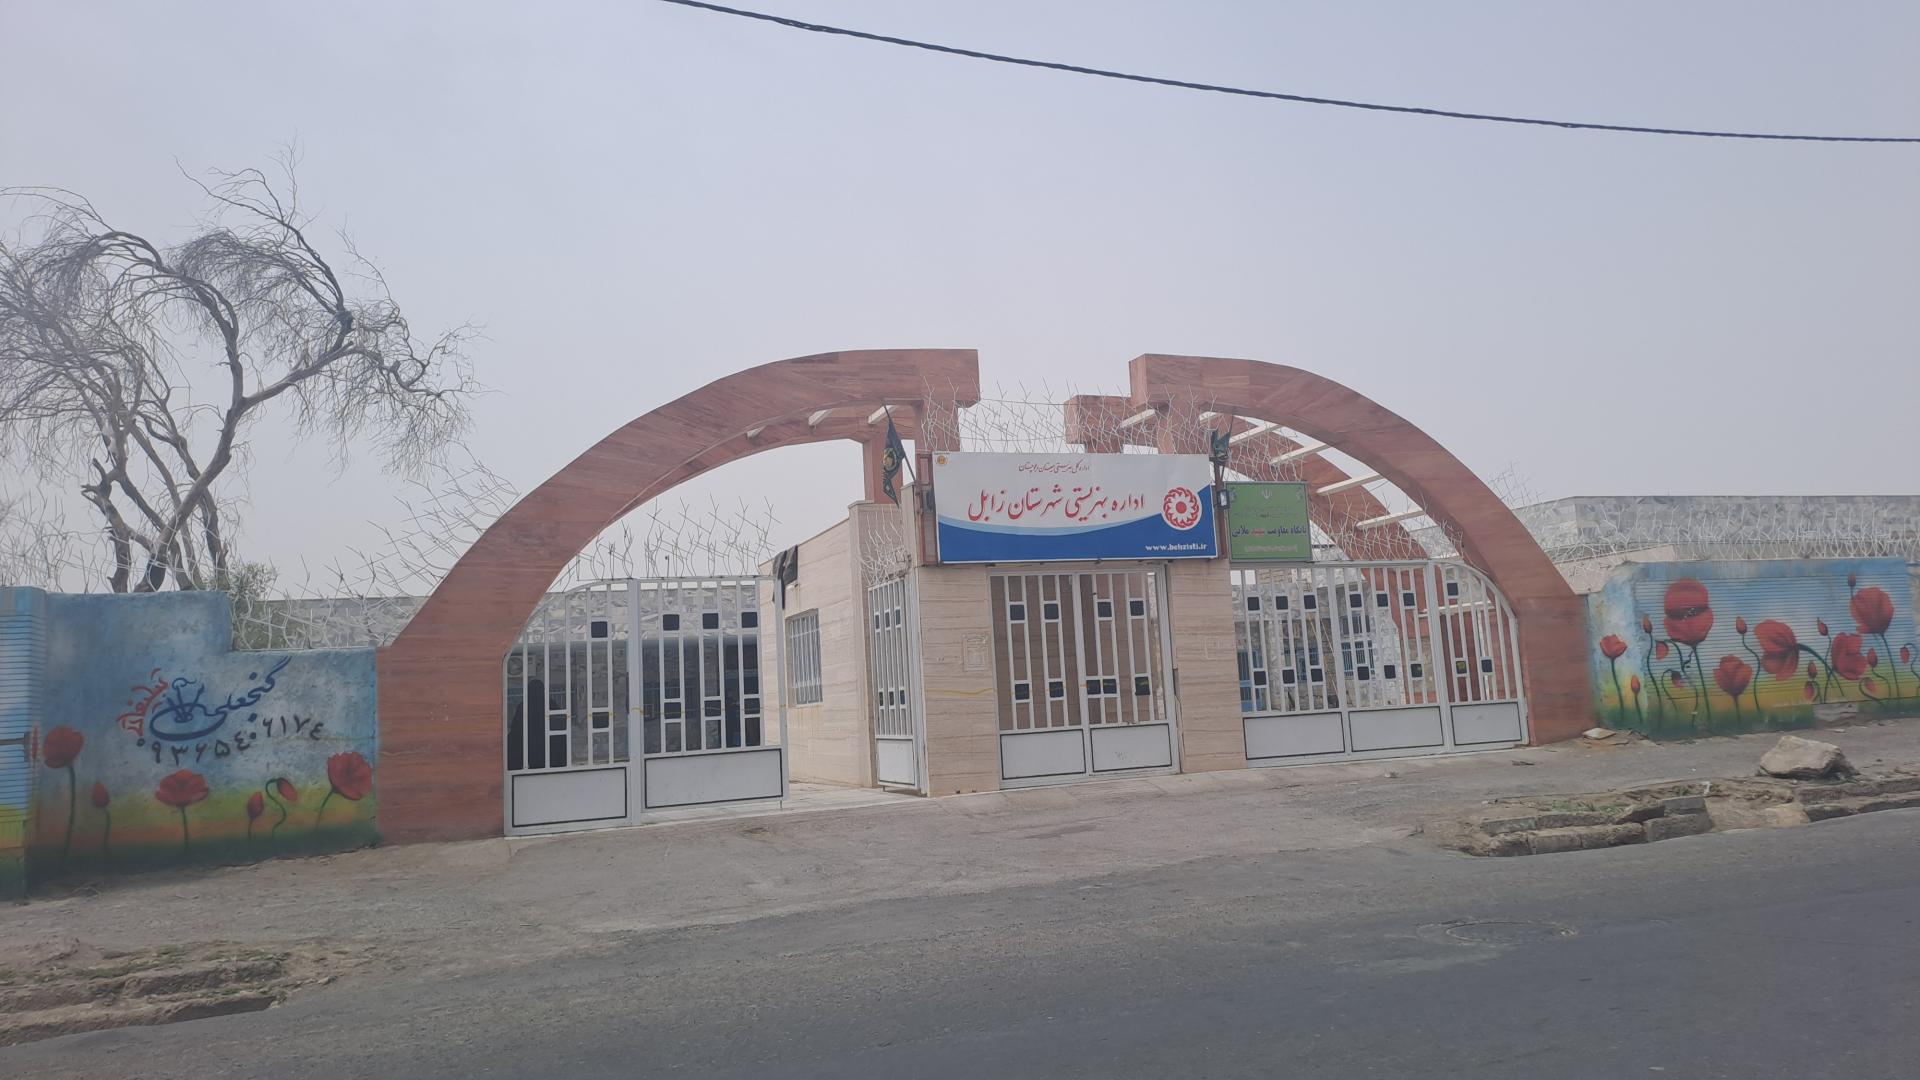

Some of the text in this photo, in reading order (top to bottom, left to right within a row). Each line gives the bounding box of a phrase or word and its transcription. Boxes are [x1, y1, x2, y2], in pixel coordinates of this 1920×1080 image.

[968, 484, 1145, 522] اداره بهزیستی شهرستان زابل
[1145, 543, 1208, 551] www.behzisti.ir
